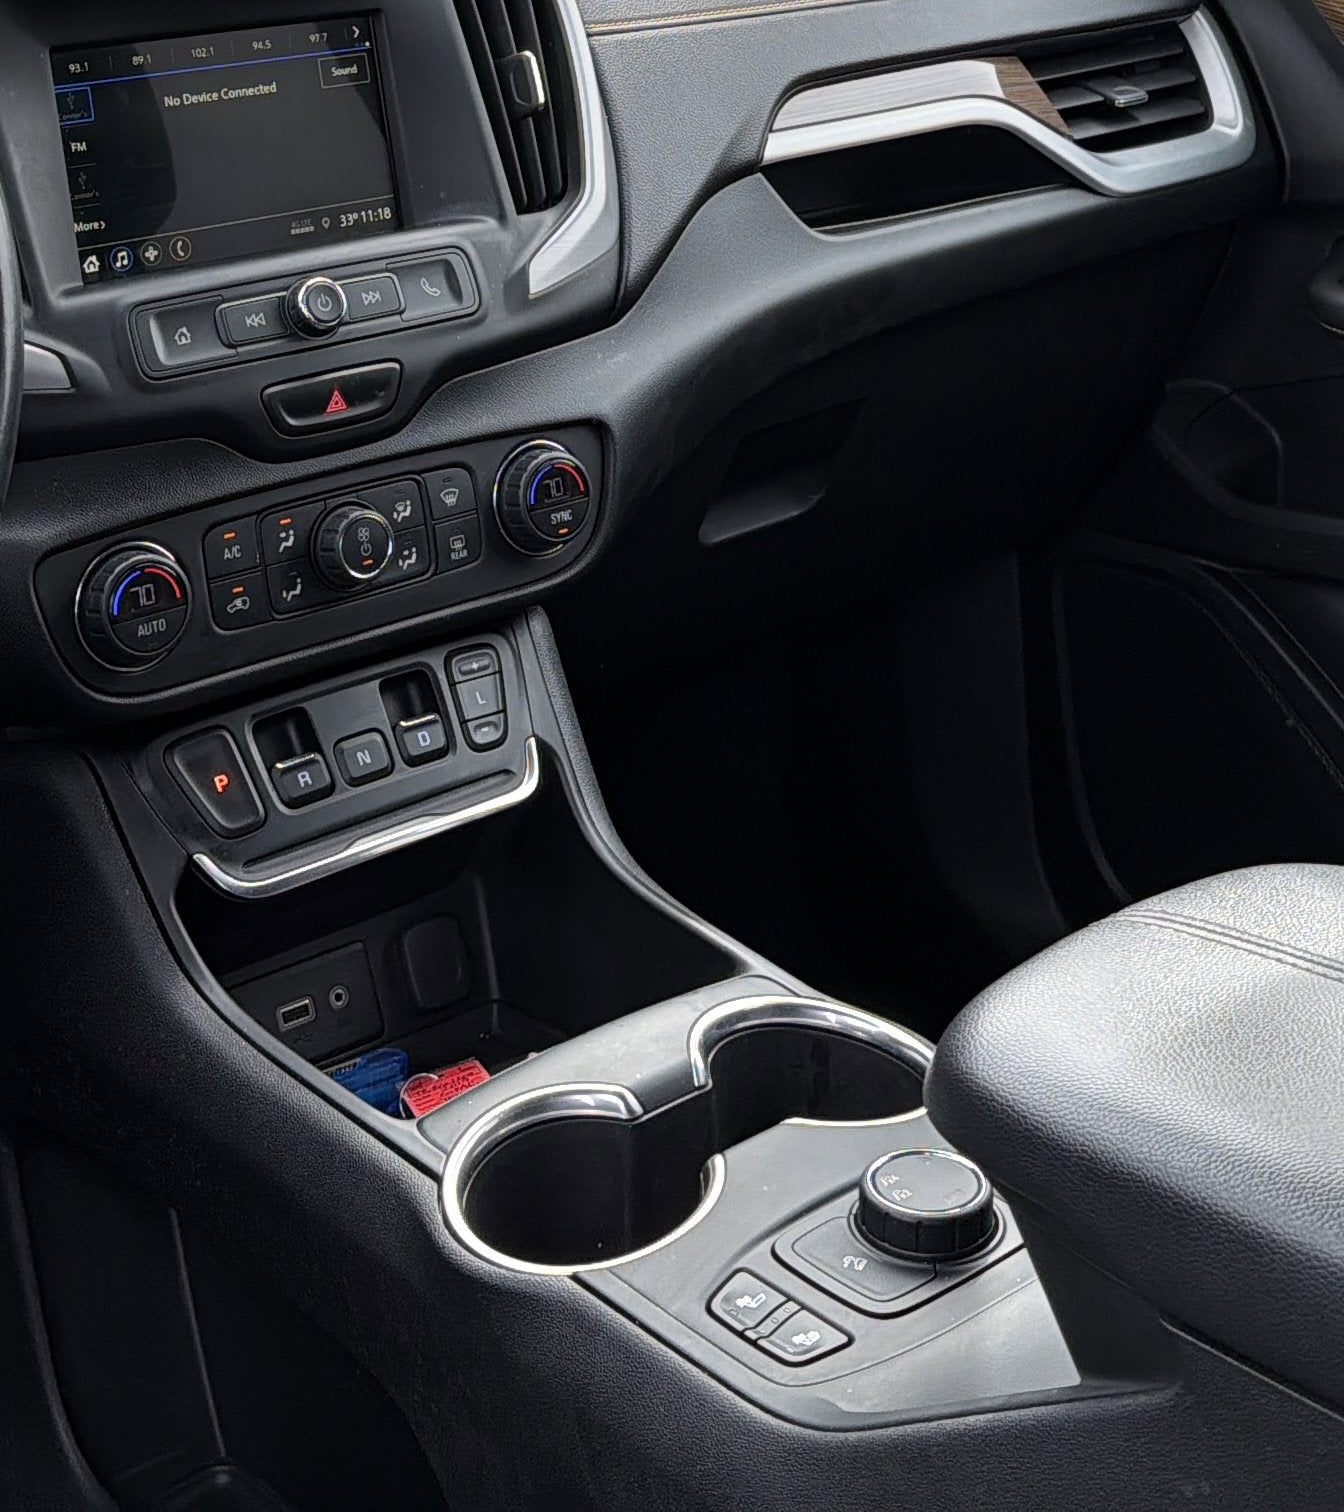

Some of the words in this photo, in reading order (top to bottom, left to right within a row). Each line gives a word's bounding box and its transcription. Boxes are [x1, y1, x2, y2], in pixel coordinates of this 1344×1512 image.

[68, 61, 89, 75] 93.1
[132, 54, 152, 67] 89.1
[191, 46, 215, 59] 102.1
[252, 39, 272, 52] 94.5
[308, 32, 328, 44] 97.7
[331, 64, 358, 78] Sound
[164, 94, 181, 108] No
[183, 88, 218, 106] Device
[220, 81, 277, 102] Connected
[71, 141, 87, 153] FM
[361, 206, 392, 224] 11:18
[73, 220, 100, 233] More
[543, 476, 564, 498] 70
[550, 509, 573, 525] SYNC
[223, 545, 242, 561] A/C
[450, 549, 468, 561] REAR
[130, 583, 156, 607] 70
[137, 618, 167, 638] AUTO
[475, 691, 488, 706] L
[417, 730, 432, 748] D
[355, 749, 372, 766] N
[213, 773, 230, 793] P
[297, 771, 313, 788] R
